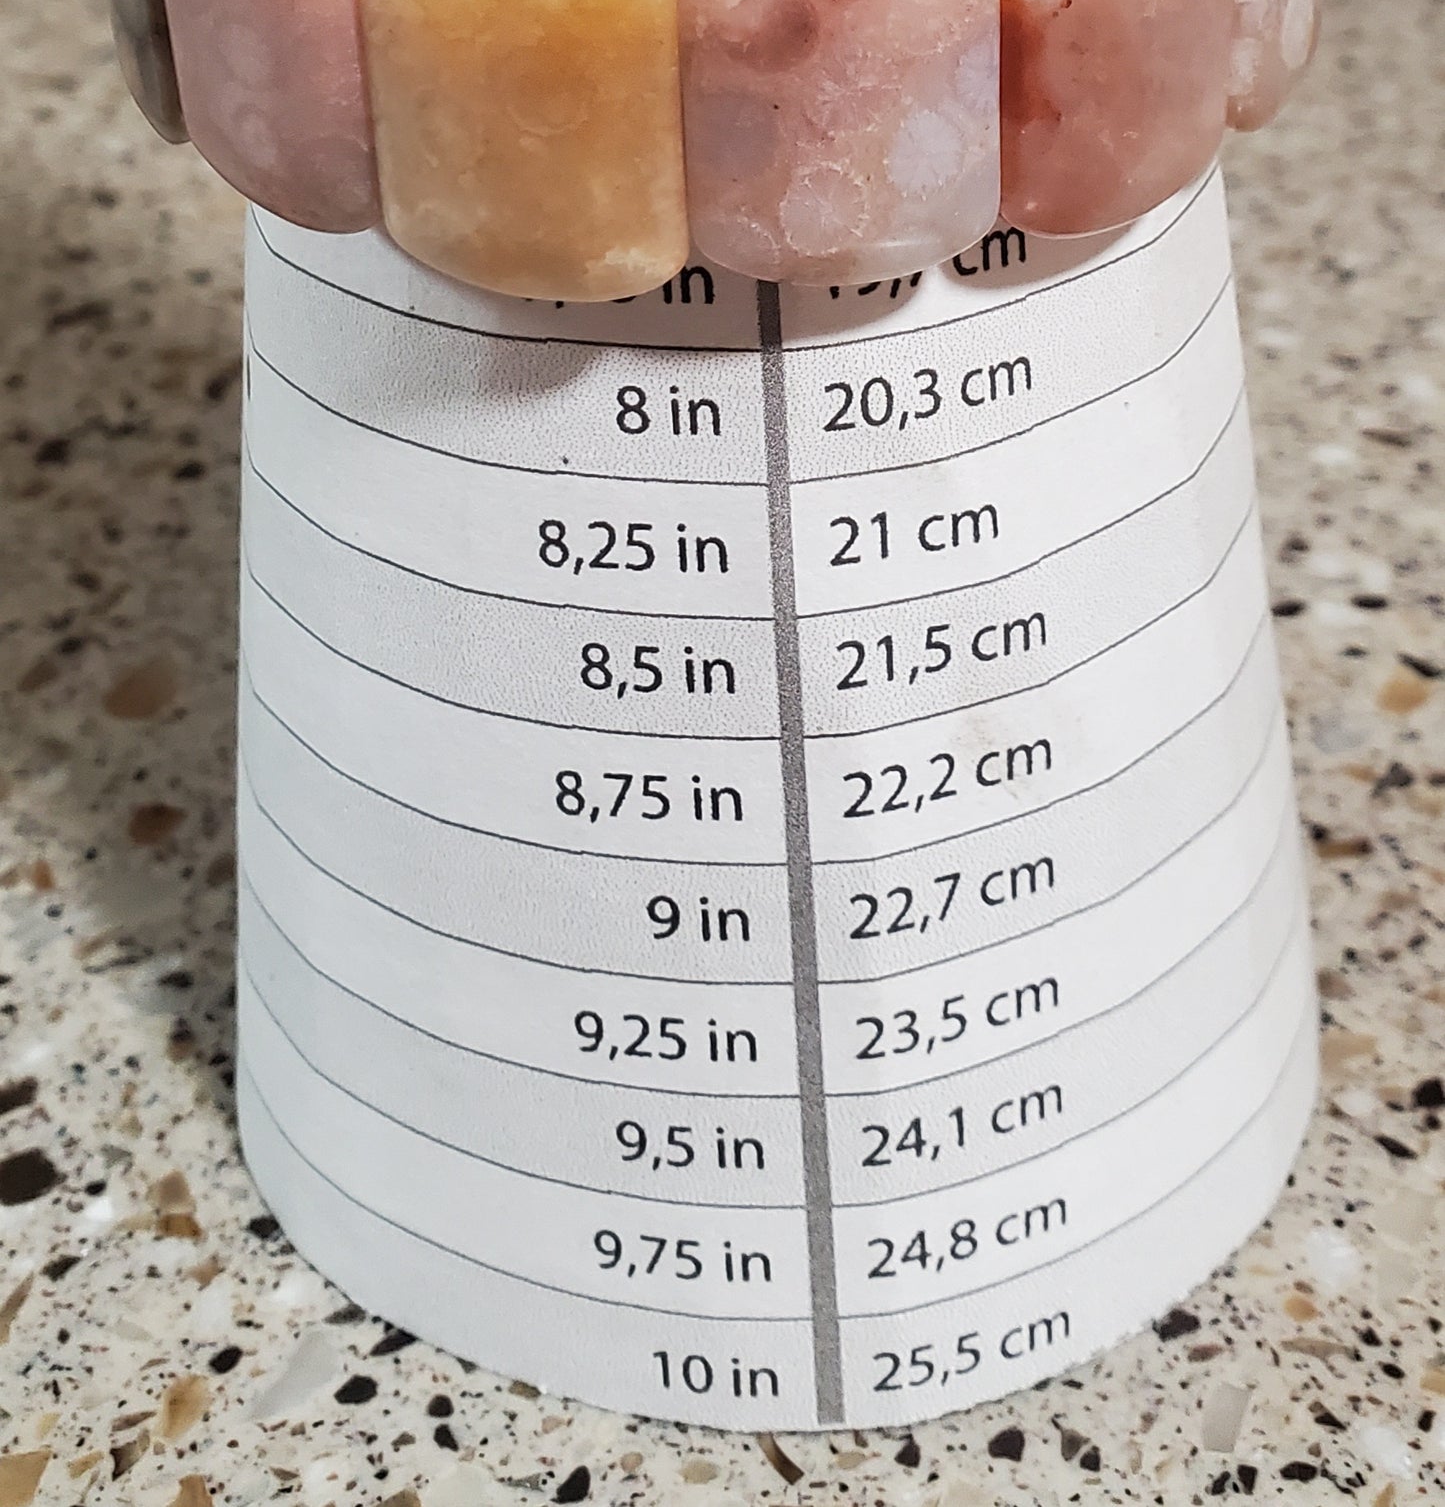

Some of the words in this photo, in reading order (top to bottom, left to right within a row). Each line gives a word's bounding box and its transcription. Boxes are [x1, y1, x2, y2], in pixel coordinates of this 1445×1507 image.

[616, 385, 651, 435] 8
[669, 385, 721, 436] in
[822, 368, 942, 433] 20,3
[960, 356, 1032, 407] cm
[538, 519, 655, 576] 8,25
[676, 523, 729, 574] in
[830, 511, 889, 567] 21
[918, 504, 999, 552] cm
[580, 642, 663, 700] 8,5
[683, 646, 736, 694] in
[836, 624, 952, 691] 21,5
[971, 612, 1047, 662] cm
[555, 770, 671, 824] 8,75
[691, 774, 743, 822] in
[843, 753, 957, 819] 22,2
[975, 738, 1052, 787] cm
[646, 895, 681, 940] 9
[699, 896, 750, 942] in
[849, 872, 961, 940] 22,7
[980, 857, 1055, 907] cm
[574, 1010, 687, 1061] 9,25
[708, 1019, 757, 1062] in
[855, 995, 967, 1060] 23,5
[985, 977, 1059, 1027] cm
[616, 1120, 695, 1171] 9,5
[716, 1126, 765, 1170] in
[862, 1106, 965, 1167] 24,1
[991, 1085, 1063, 1134] cm
[593, 1229, 703, 1280] 9,75
[723, 1241, 771, 1282] in
[867, 1219, 978, 1279] 24,8
[995, 1198, 1067, 1246] cm
[653, 1351, 714, 1394] 10
[731, 1357, 779, 1397] in
[873, 1332, 981, 1392] 25,5
[1000, 1311, 1070, 1359] cm
